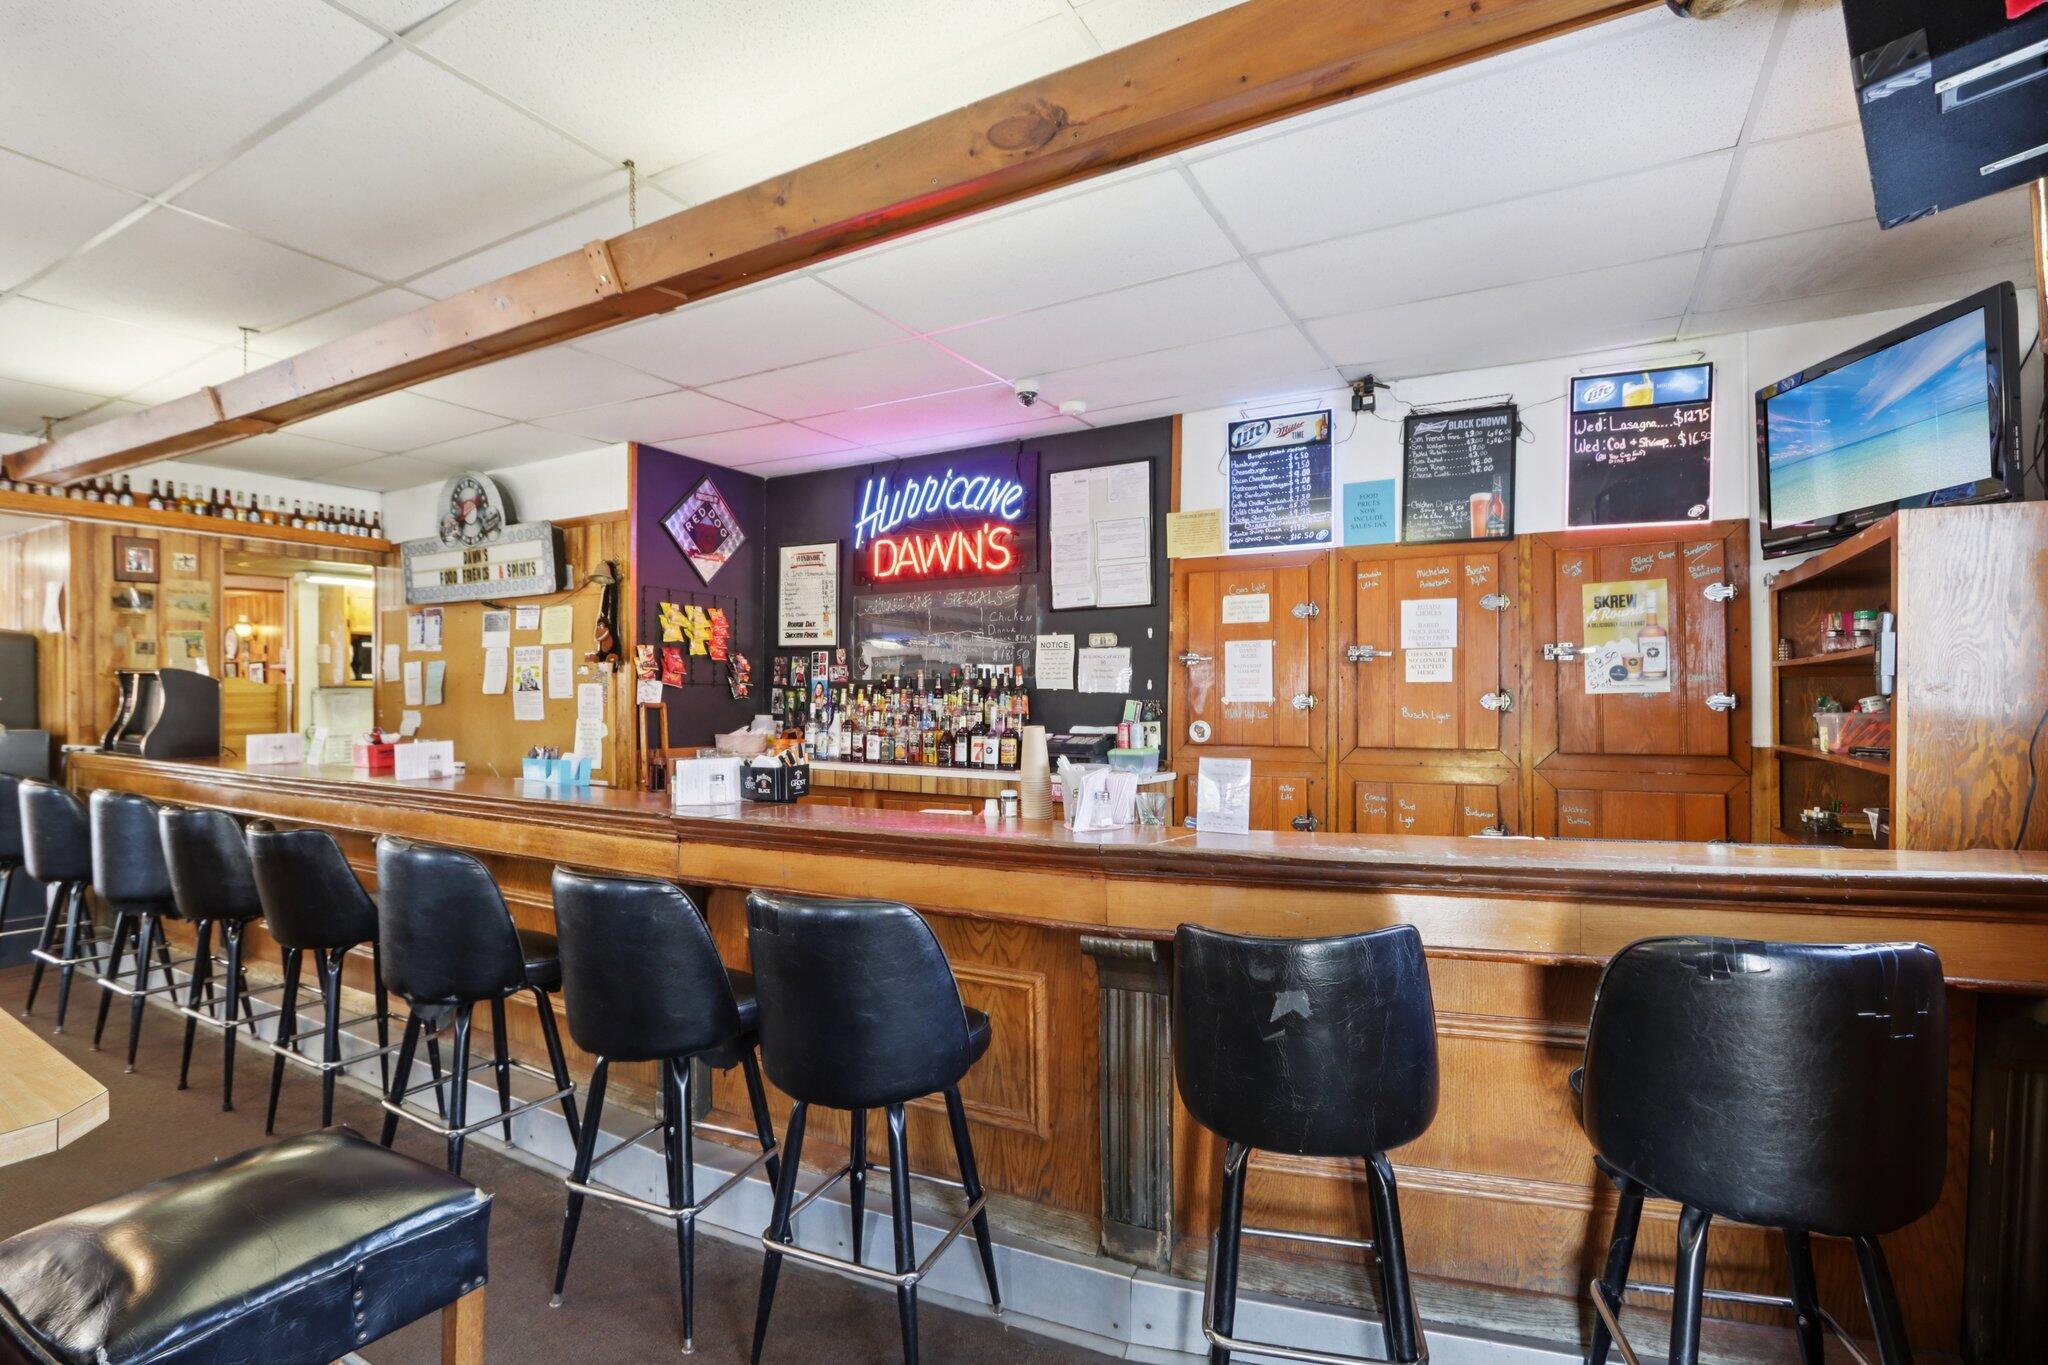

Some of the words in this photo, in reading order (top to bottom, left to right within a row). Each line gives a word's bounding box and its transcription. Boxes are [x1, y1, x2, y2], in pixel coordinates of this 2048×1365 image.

[1273, 421, 1305, 438] Miller
[1448, 419, 1474, 430] BLACK
[1476, 416, 1507, 428] CROWN
[854, 468, 1024, 549] Hurricane
[685, 508, 706, 532] RED
[708, 509, 728, 538] DOG
[874, 522, 1013, 577] DAWN'S
[507, 561, 536, 578] SPIRITS
[1594, 594, 1637, 609] SKREW
[973, 742, 984, 762] 7
